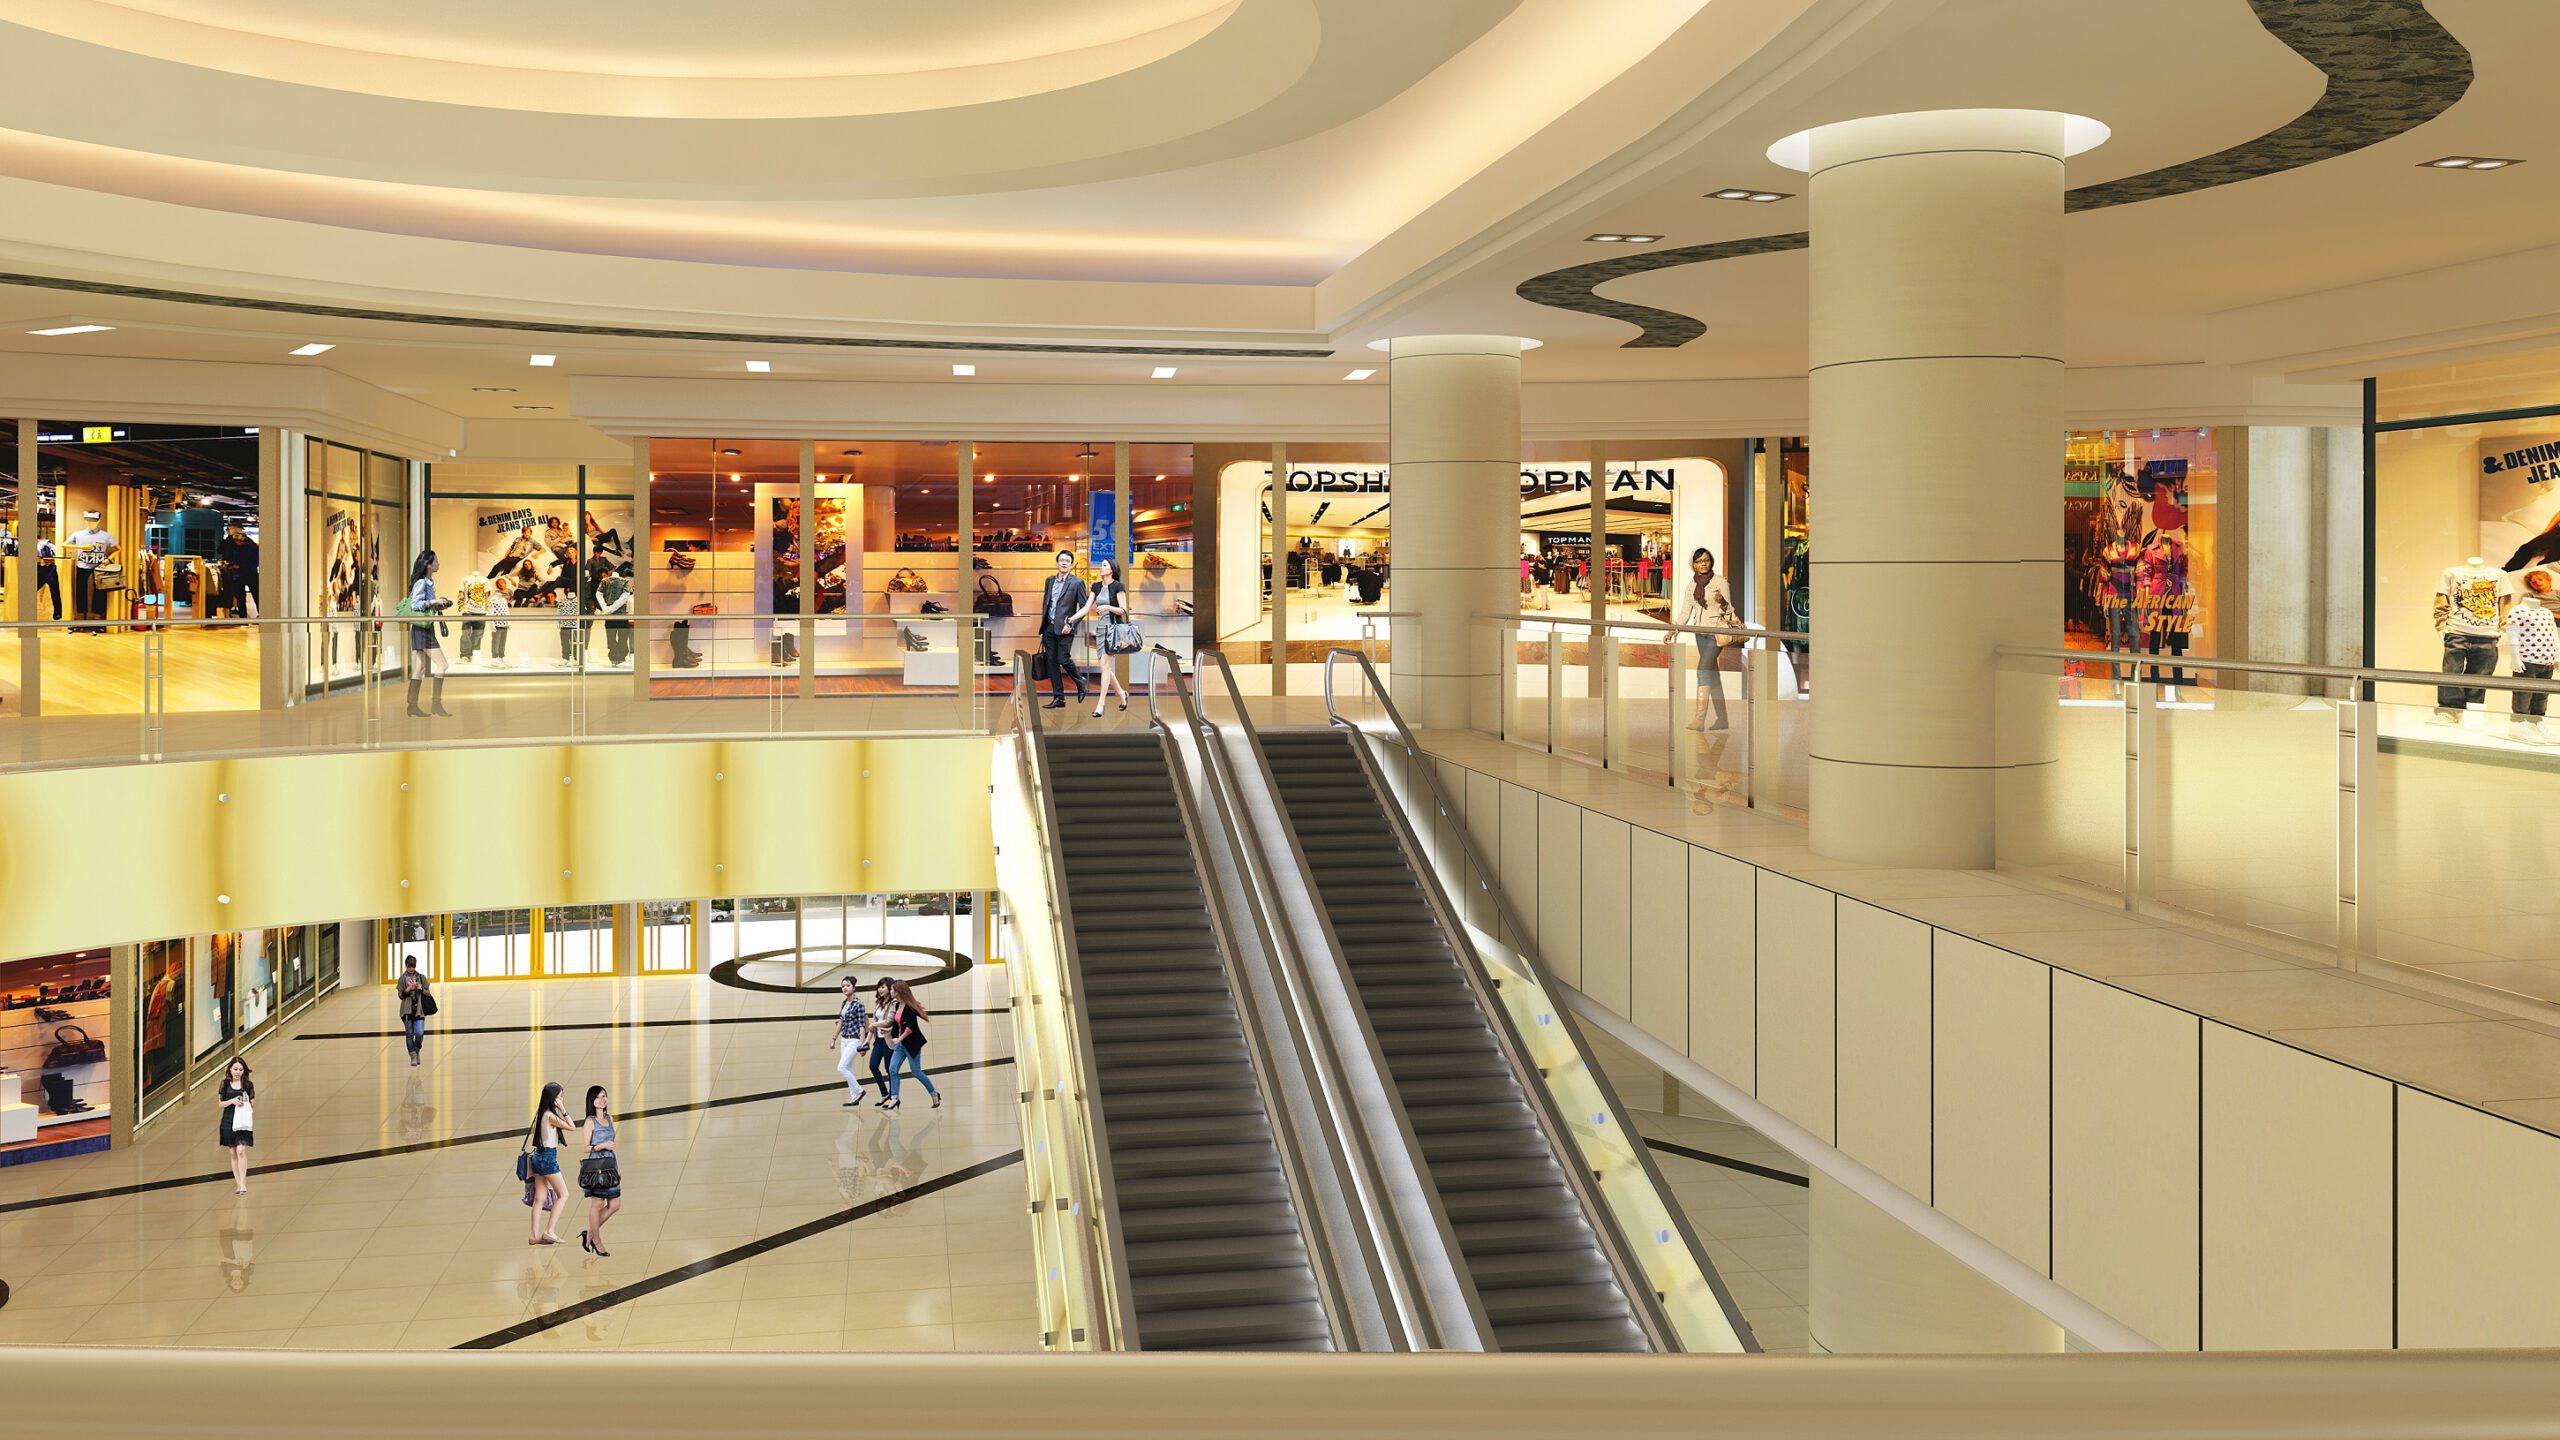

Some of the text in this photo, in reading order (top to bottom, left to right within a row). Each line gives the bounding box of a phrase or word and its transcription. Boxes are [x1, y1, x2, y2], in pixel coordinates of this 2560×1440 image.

[2503, 440, 2560, 470] DENIM
[1264, 470, 1390, 493] OPSH
[487, 512, 512, 525] DENIM
[512, 507, 533, 518] DAYS
[497, 520, 521, 533] JEANS
[1547, 536, 1592, 544] TOPMAN
[2105, 591, 2195, 609] The AFRICAN
[2144, 611, 2195, 633] STYLE
